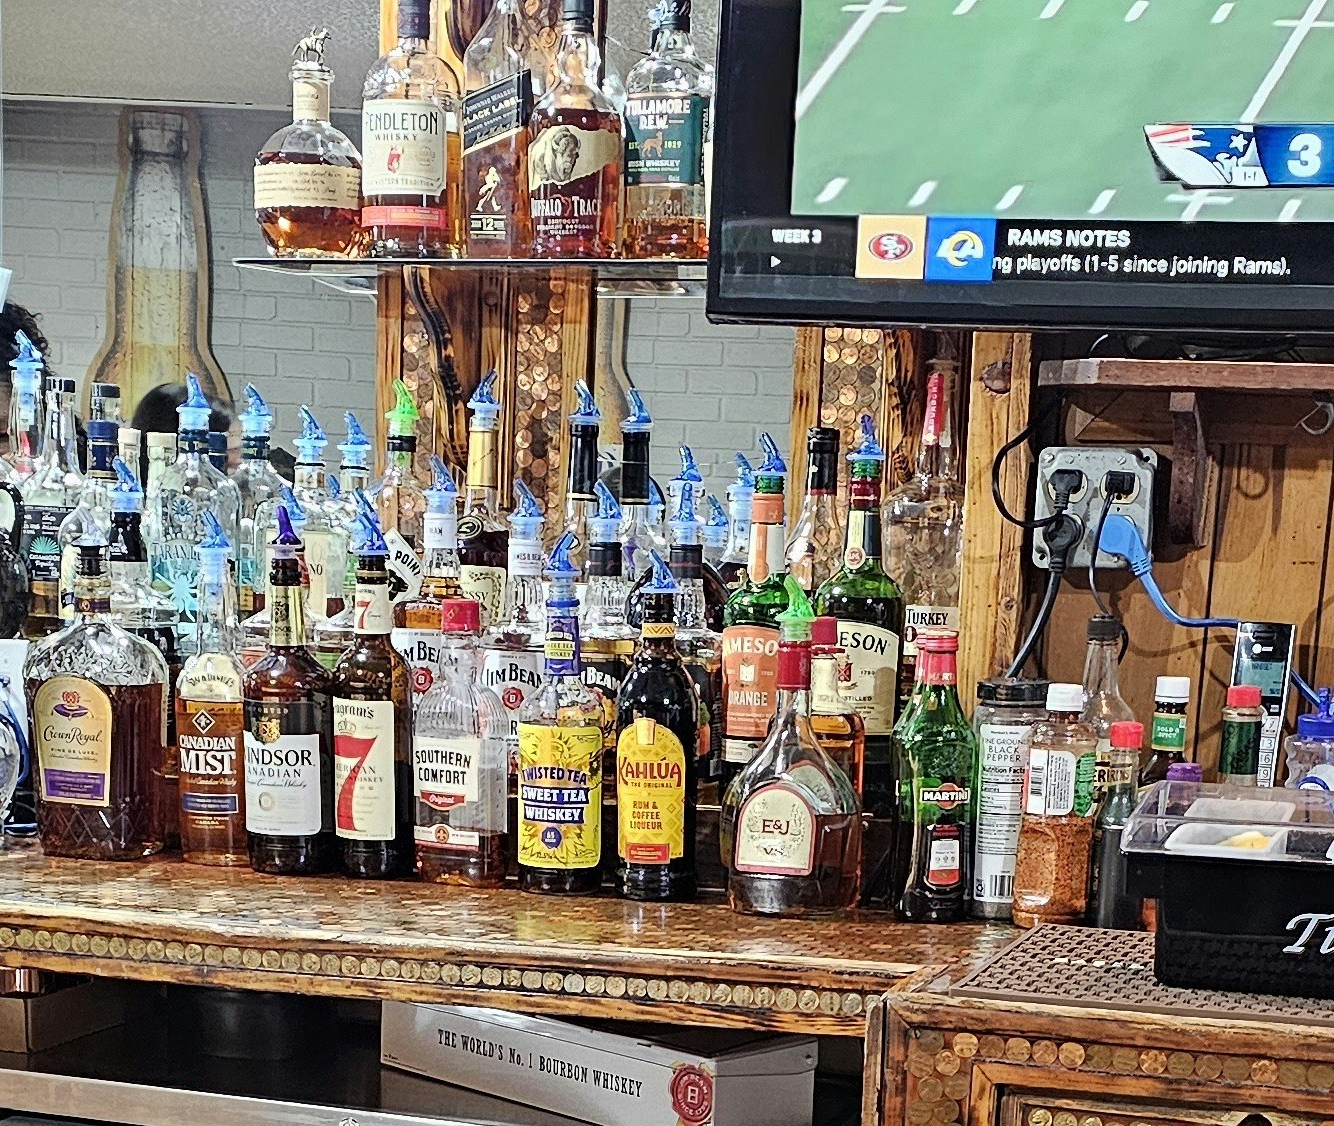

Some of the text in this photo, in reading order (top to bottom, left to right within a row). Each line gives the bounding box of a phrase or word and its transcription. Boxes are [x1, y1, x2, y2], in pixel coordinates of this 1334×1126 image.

[375, 132, 419, 141] WHISKY
[1286, 132, 1323, 179] 3
[482, 218, 494, 231] 12
[772, 229, 822, 244] WEEK 3
[1007, 228, 1131, 248] RAMS NOTES
[1016, 254, 1081, 275] playoffs
[1084, 254, 1119, 273] (1-5
[1123, 254, 1169, 273] since
[1169, 255, 1229, 278] joining
[1232, 255, 1291, 276] Rams).
[905, 609, 949, 627] TURKEY
[724, 636, 780, 657] AMESO
[840, 631, 888, 656] ESON
[729, 689, 768, 707] ORANGE
[43, 725, 102, 746] Crown Royal
[179, 734, 237, 751] CANADIAN
[247, 746, 314, 768] INDSOR
[986, 753, 1022, 762] PEPPER
[988, 745, 1020, 755] BLACK
[179, 748, 237, 775] MIST
[415, 750, 472, 769] SOUTHERN
[336, 763, 377, 775] ERICAN
[418, 767, 468, 786] COMFORT
[522, 766, 588, 785] TWISTED TEA
[618, 756, 683, 789] KAHLÚA
[334, 734, 378, 832] 7
[630, 780, 673, 790] THE ORIGINAL
[522, 787, 587, 803] SWEET TEA
[524, 805, 583, 822] WHISKEY
[632, 800, 659, 811] RUM &
[632, 811, 661, 821] COFFEE
[629, 820, 663, 831] LIQUEUR
[761, 819, 790, 836] E&J
[437, 1028, 644, 1099] THE WORLD'S No. 1 BOURBON WHISKEY
